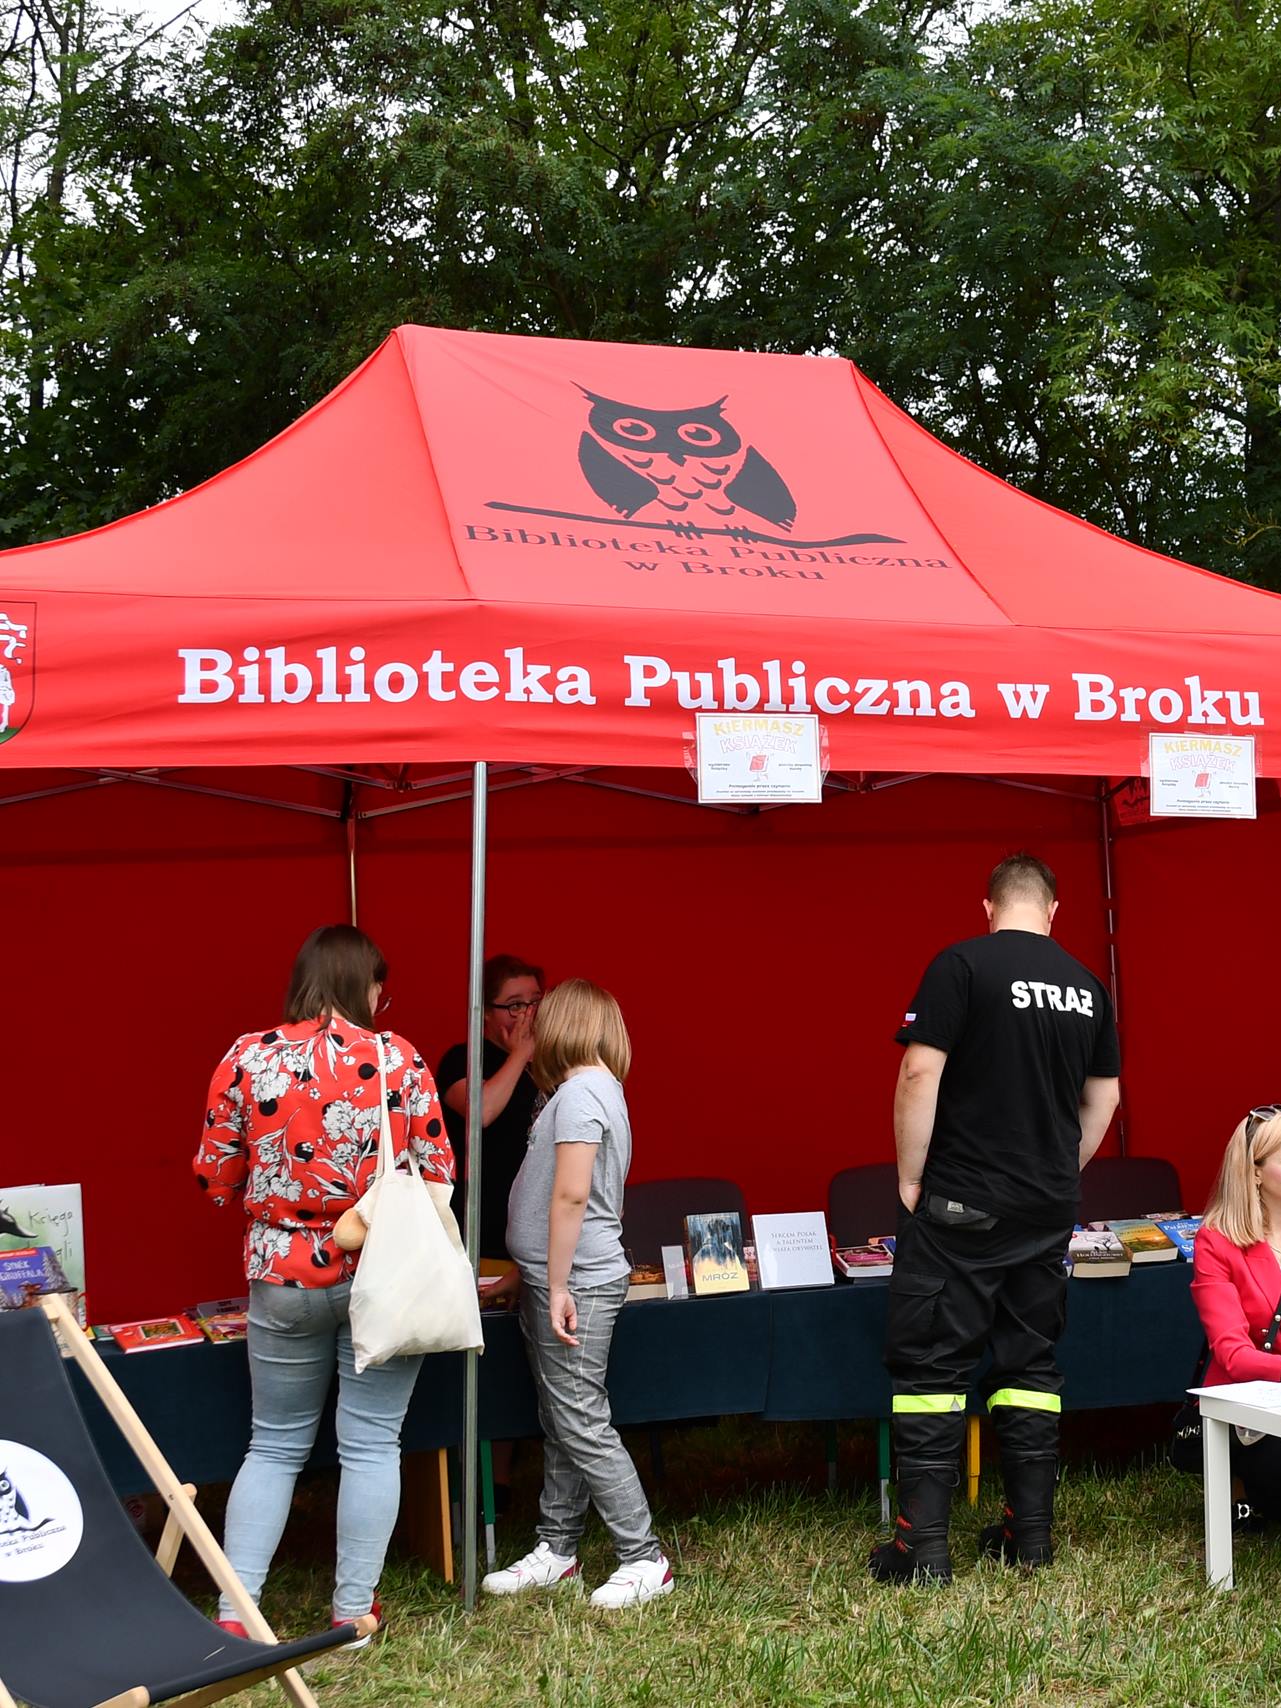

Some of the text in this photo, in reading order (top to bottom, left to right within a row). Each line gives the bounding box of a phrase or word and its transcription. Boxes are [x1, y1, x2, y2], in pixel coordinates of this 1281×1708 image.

[464, 525, 951, 569] Biblioteka Publiczna
[625, 560, 826, 580] w Broku
[178, 646, 1265, 726] Biblioteka Publiczna w Broku
[713, 719, 804, 736] KIERMASZ
[1165, 740, 1243, 757] KIERMASZ
